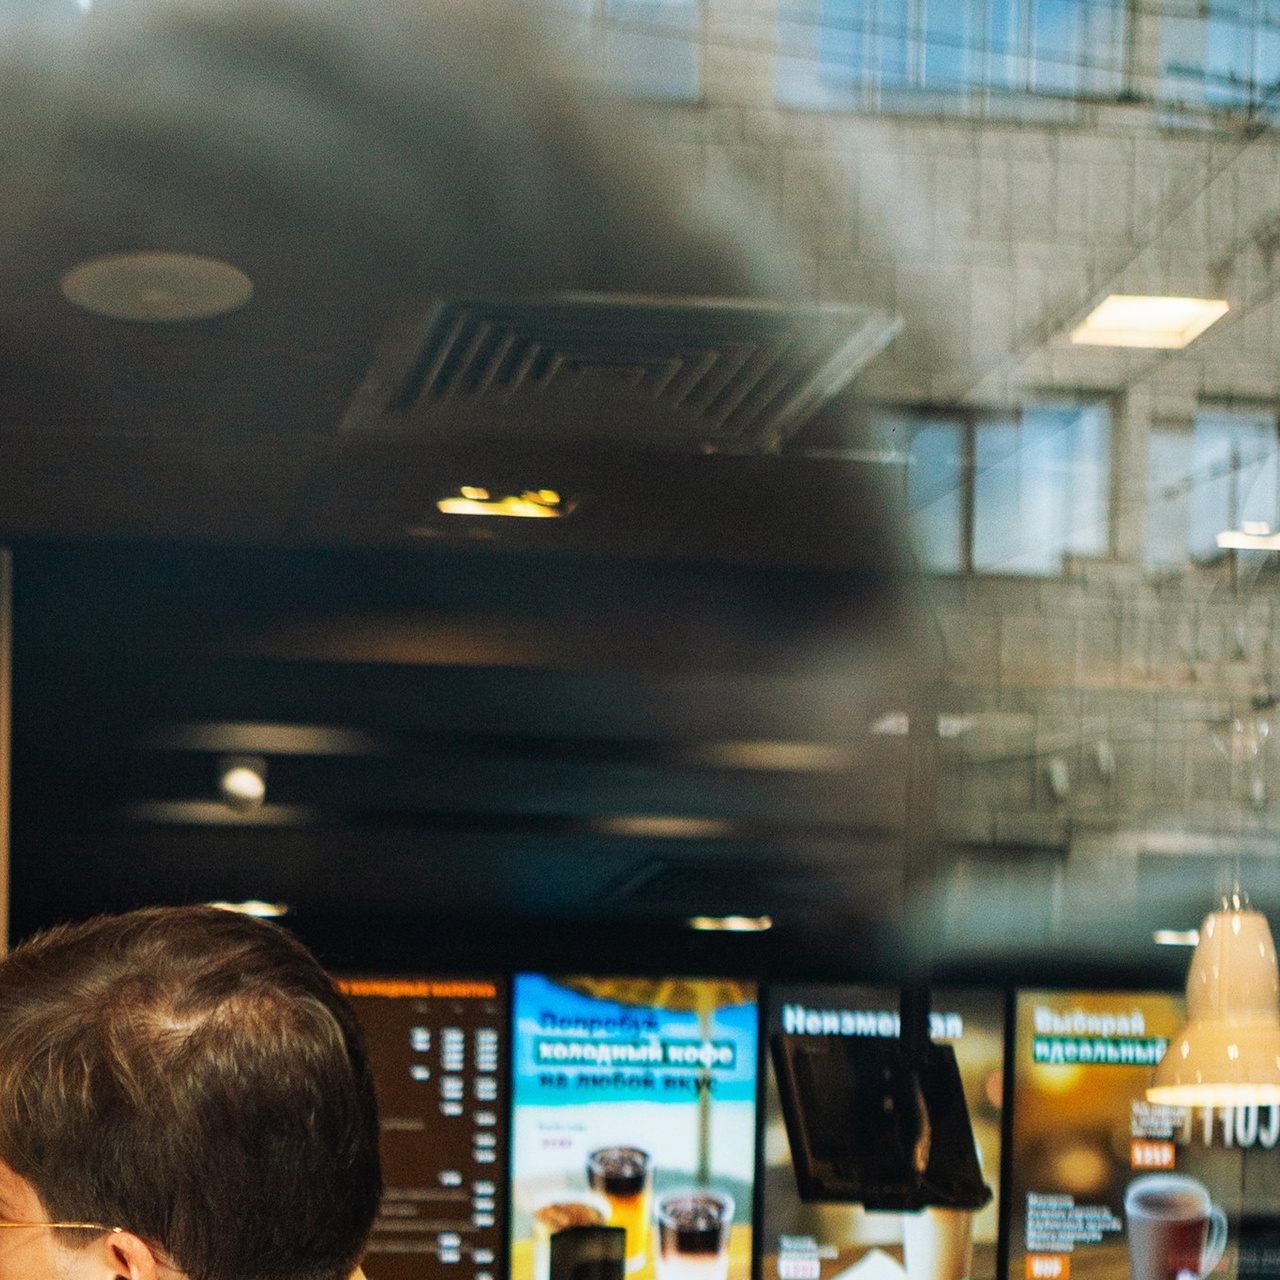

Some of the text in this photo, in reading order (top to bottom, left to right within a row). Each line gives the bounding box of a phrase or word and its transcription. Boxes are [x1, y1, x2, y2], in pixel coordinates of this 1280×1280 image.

[540, 1012, 658, 1037] Попробуй
[1034, 1006, 1145, 1036] Выбирай
[539, 1036, 733, 1068] холодный кофе
[540, 1074, 567, 1089] на
[577, 1071, 655, 1090] любой
